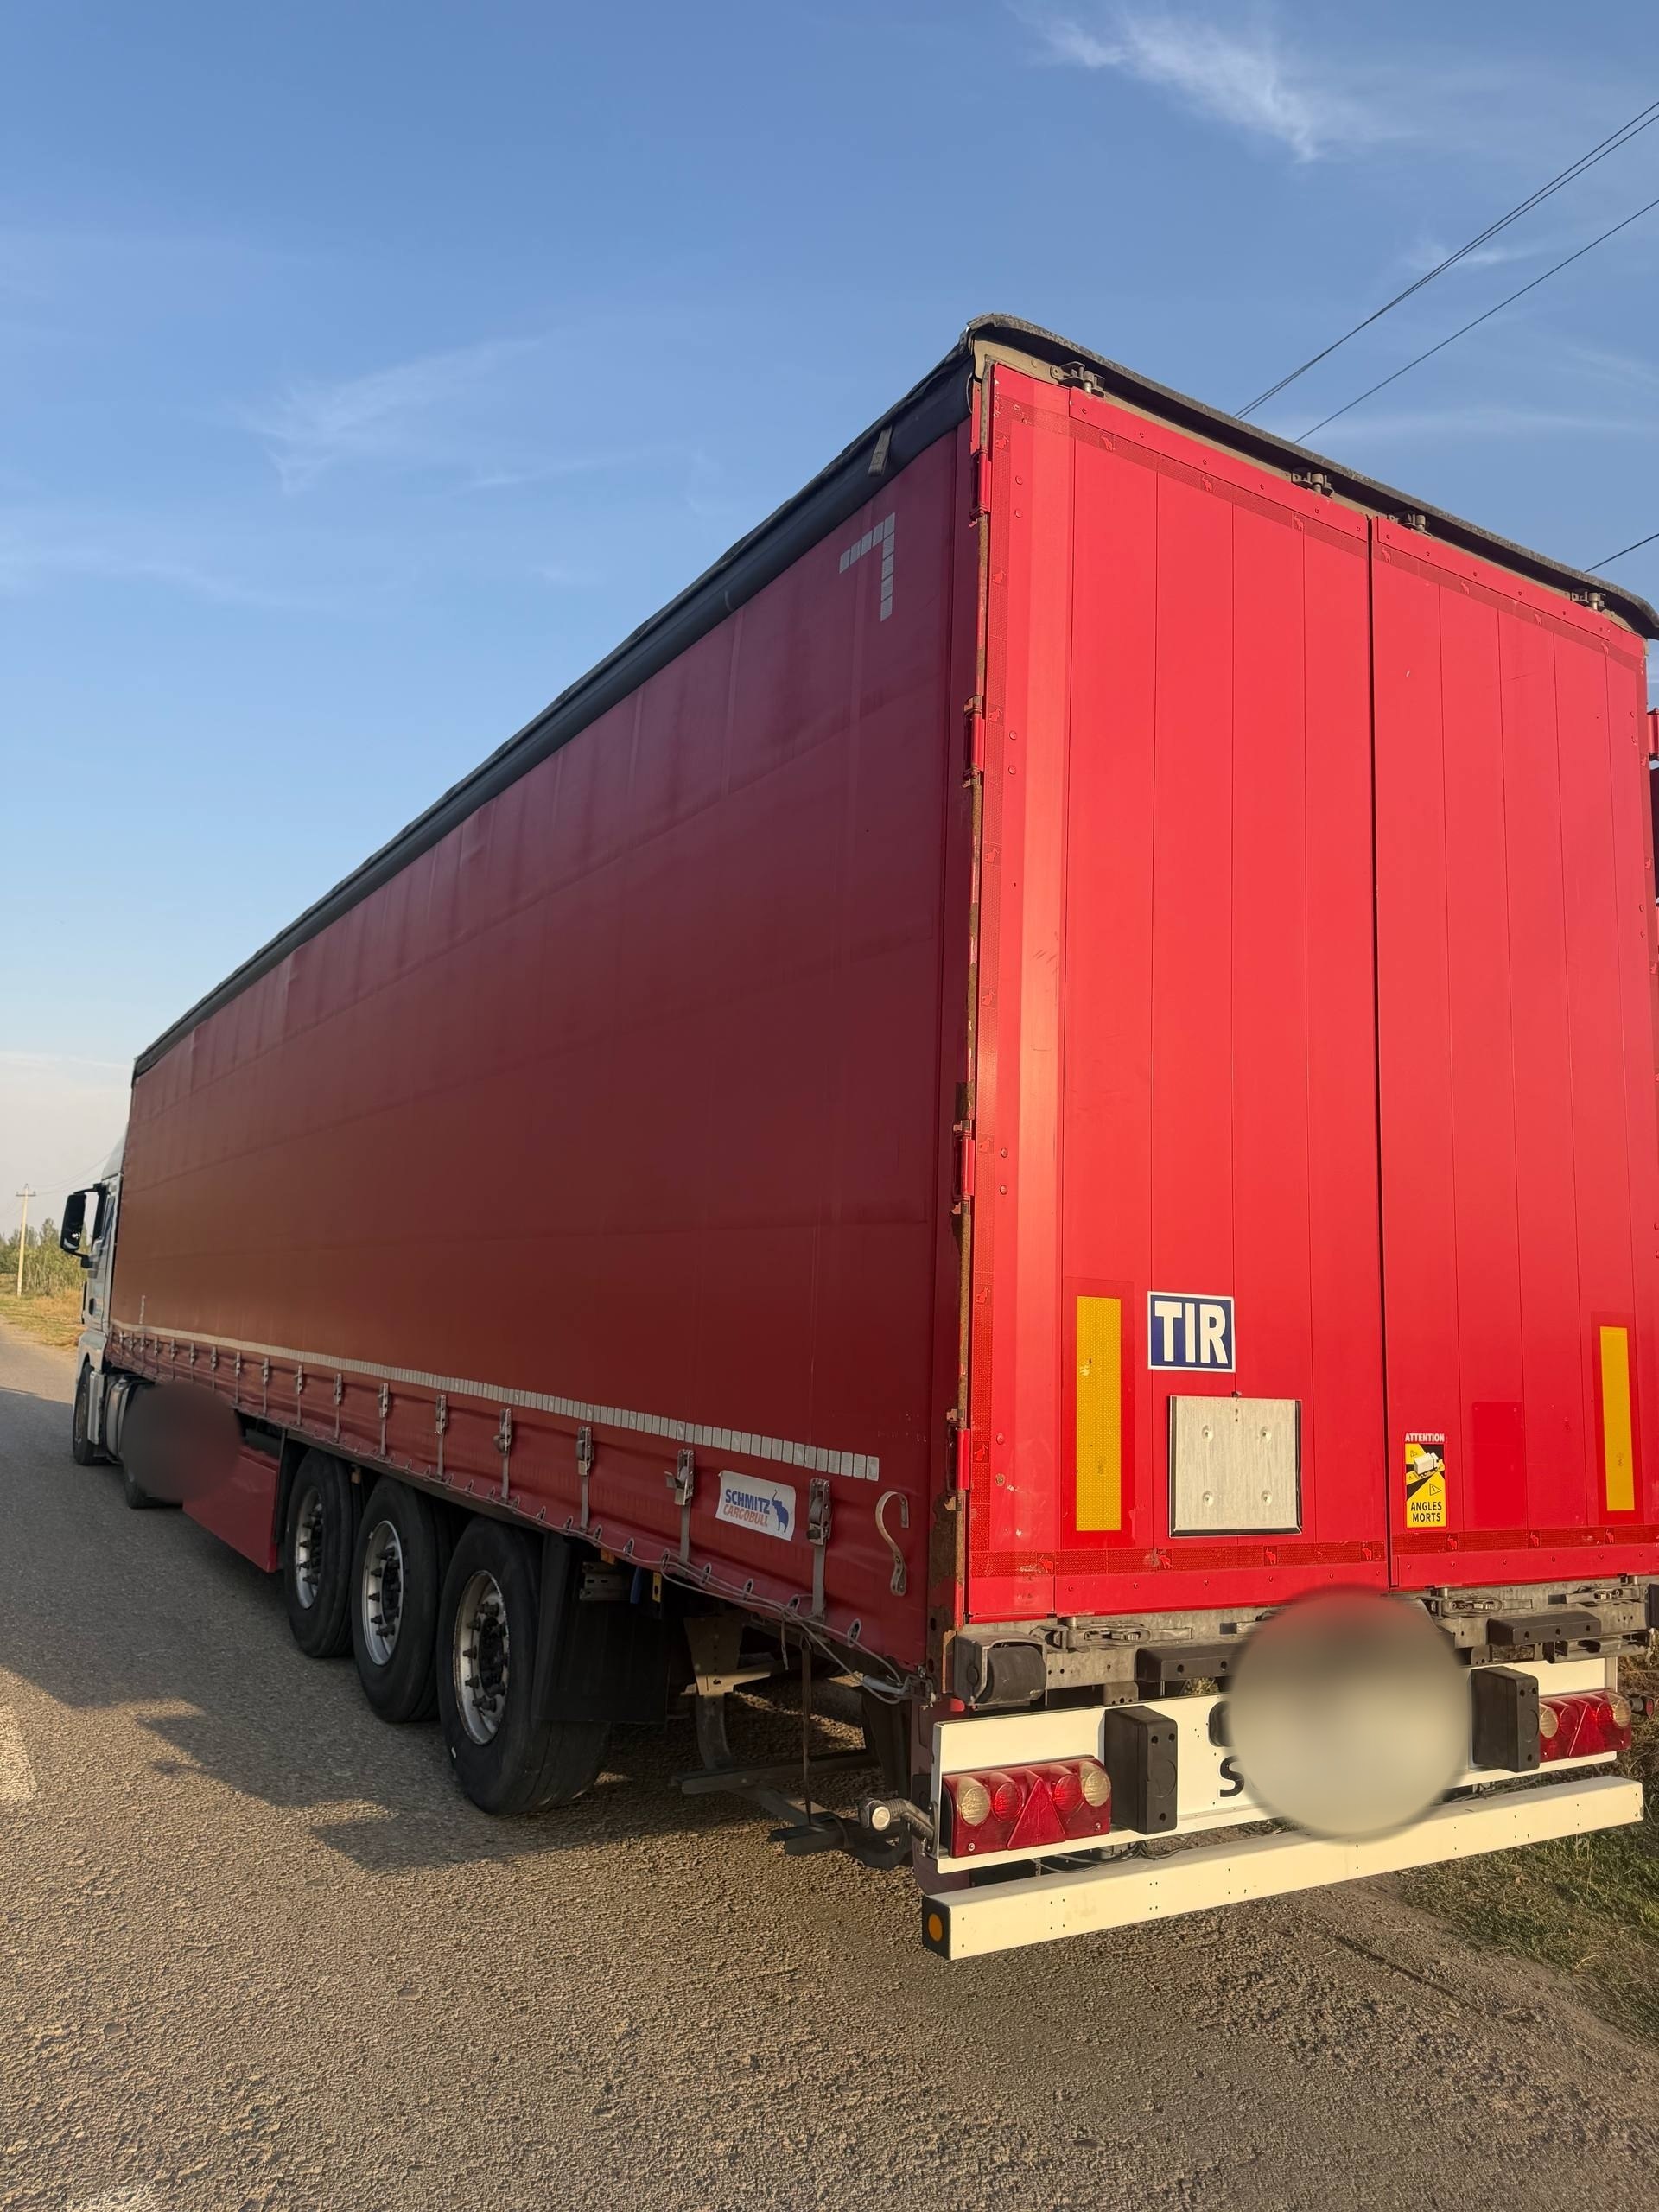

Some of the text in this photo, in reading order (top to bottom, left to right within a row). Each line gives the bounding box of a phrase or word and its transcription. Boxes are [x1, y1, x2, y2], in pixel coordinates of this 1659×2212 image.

[1154, 1300, 1229, 1364] TIR
[1404, 1433, 1445, 1443] ATTENTION
[725, 1489, 771, 1515] SCHMITZ
[1410, 1502, 1442, 1511] ANGLES
[723, 1504, 768, 1527] CARGOBULL
[1412, 1513, 1441, 1522] MORTS
